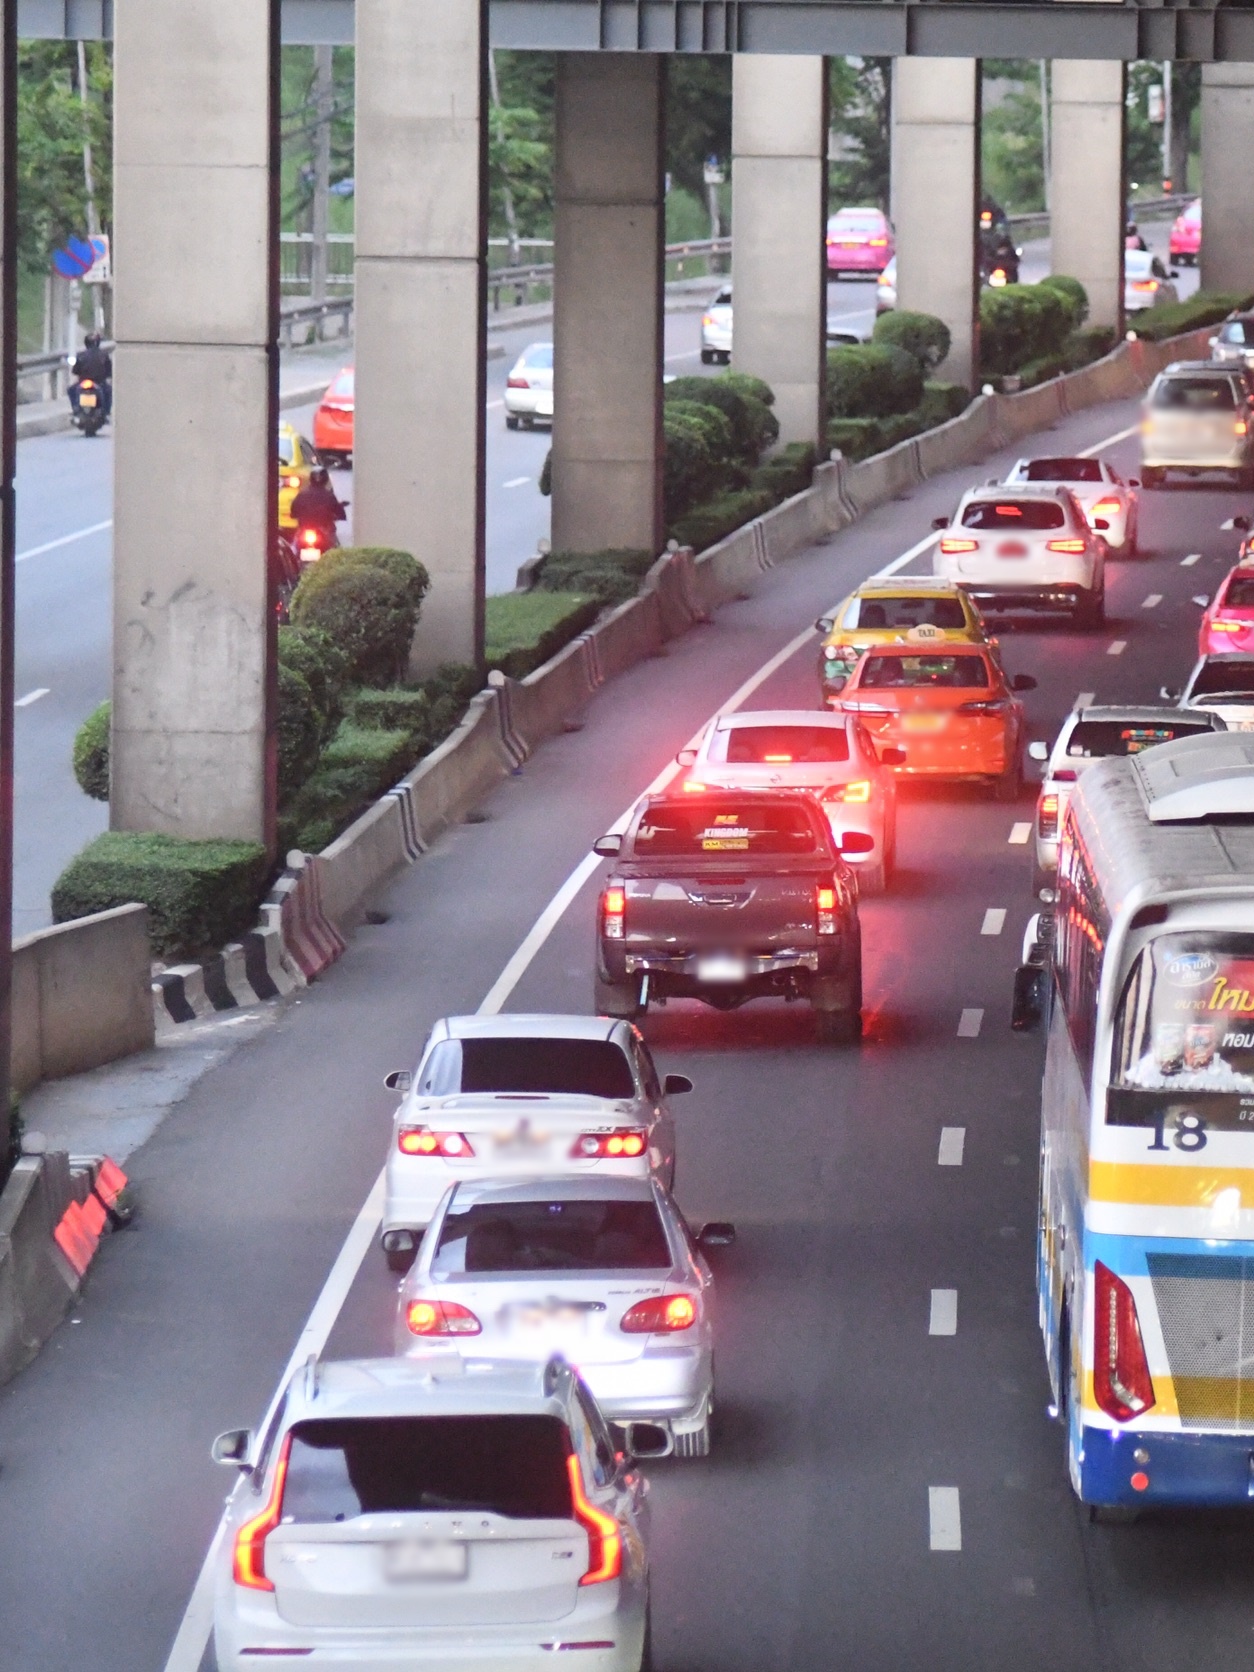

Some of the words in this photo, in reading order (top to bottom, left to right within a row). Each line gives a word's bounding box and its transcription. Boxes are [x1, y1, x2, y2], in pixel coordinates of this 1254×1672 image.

[918, 628, 936, 638] TAXI
[704, 827, 749, 838] KINGDOM
[1147, 1109, 1208, 1152] 18
